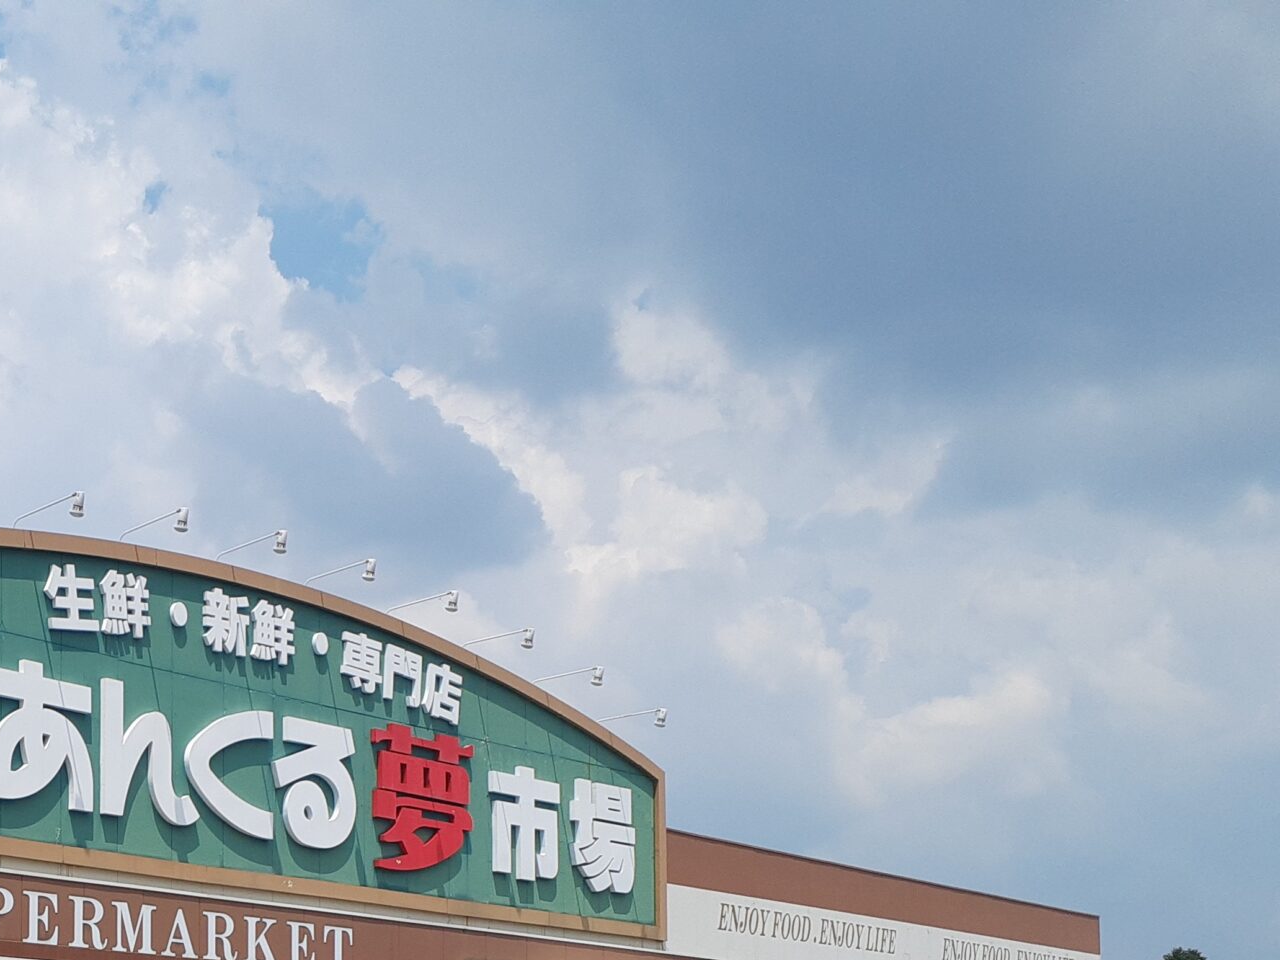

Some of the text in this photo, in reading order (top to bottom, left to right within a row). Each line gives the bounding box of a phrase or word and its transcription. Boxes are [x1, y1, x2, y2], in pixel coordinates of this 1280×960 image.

[43, 563, 463, 727] 生鮮・新鮮・専門店
[717, 903, 770, 937] ENJOY
[819, 918, 865, 950] ENJOY
[865, 925, 897, 955] LIFE
